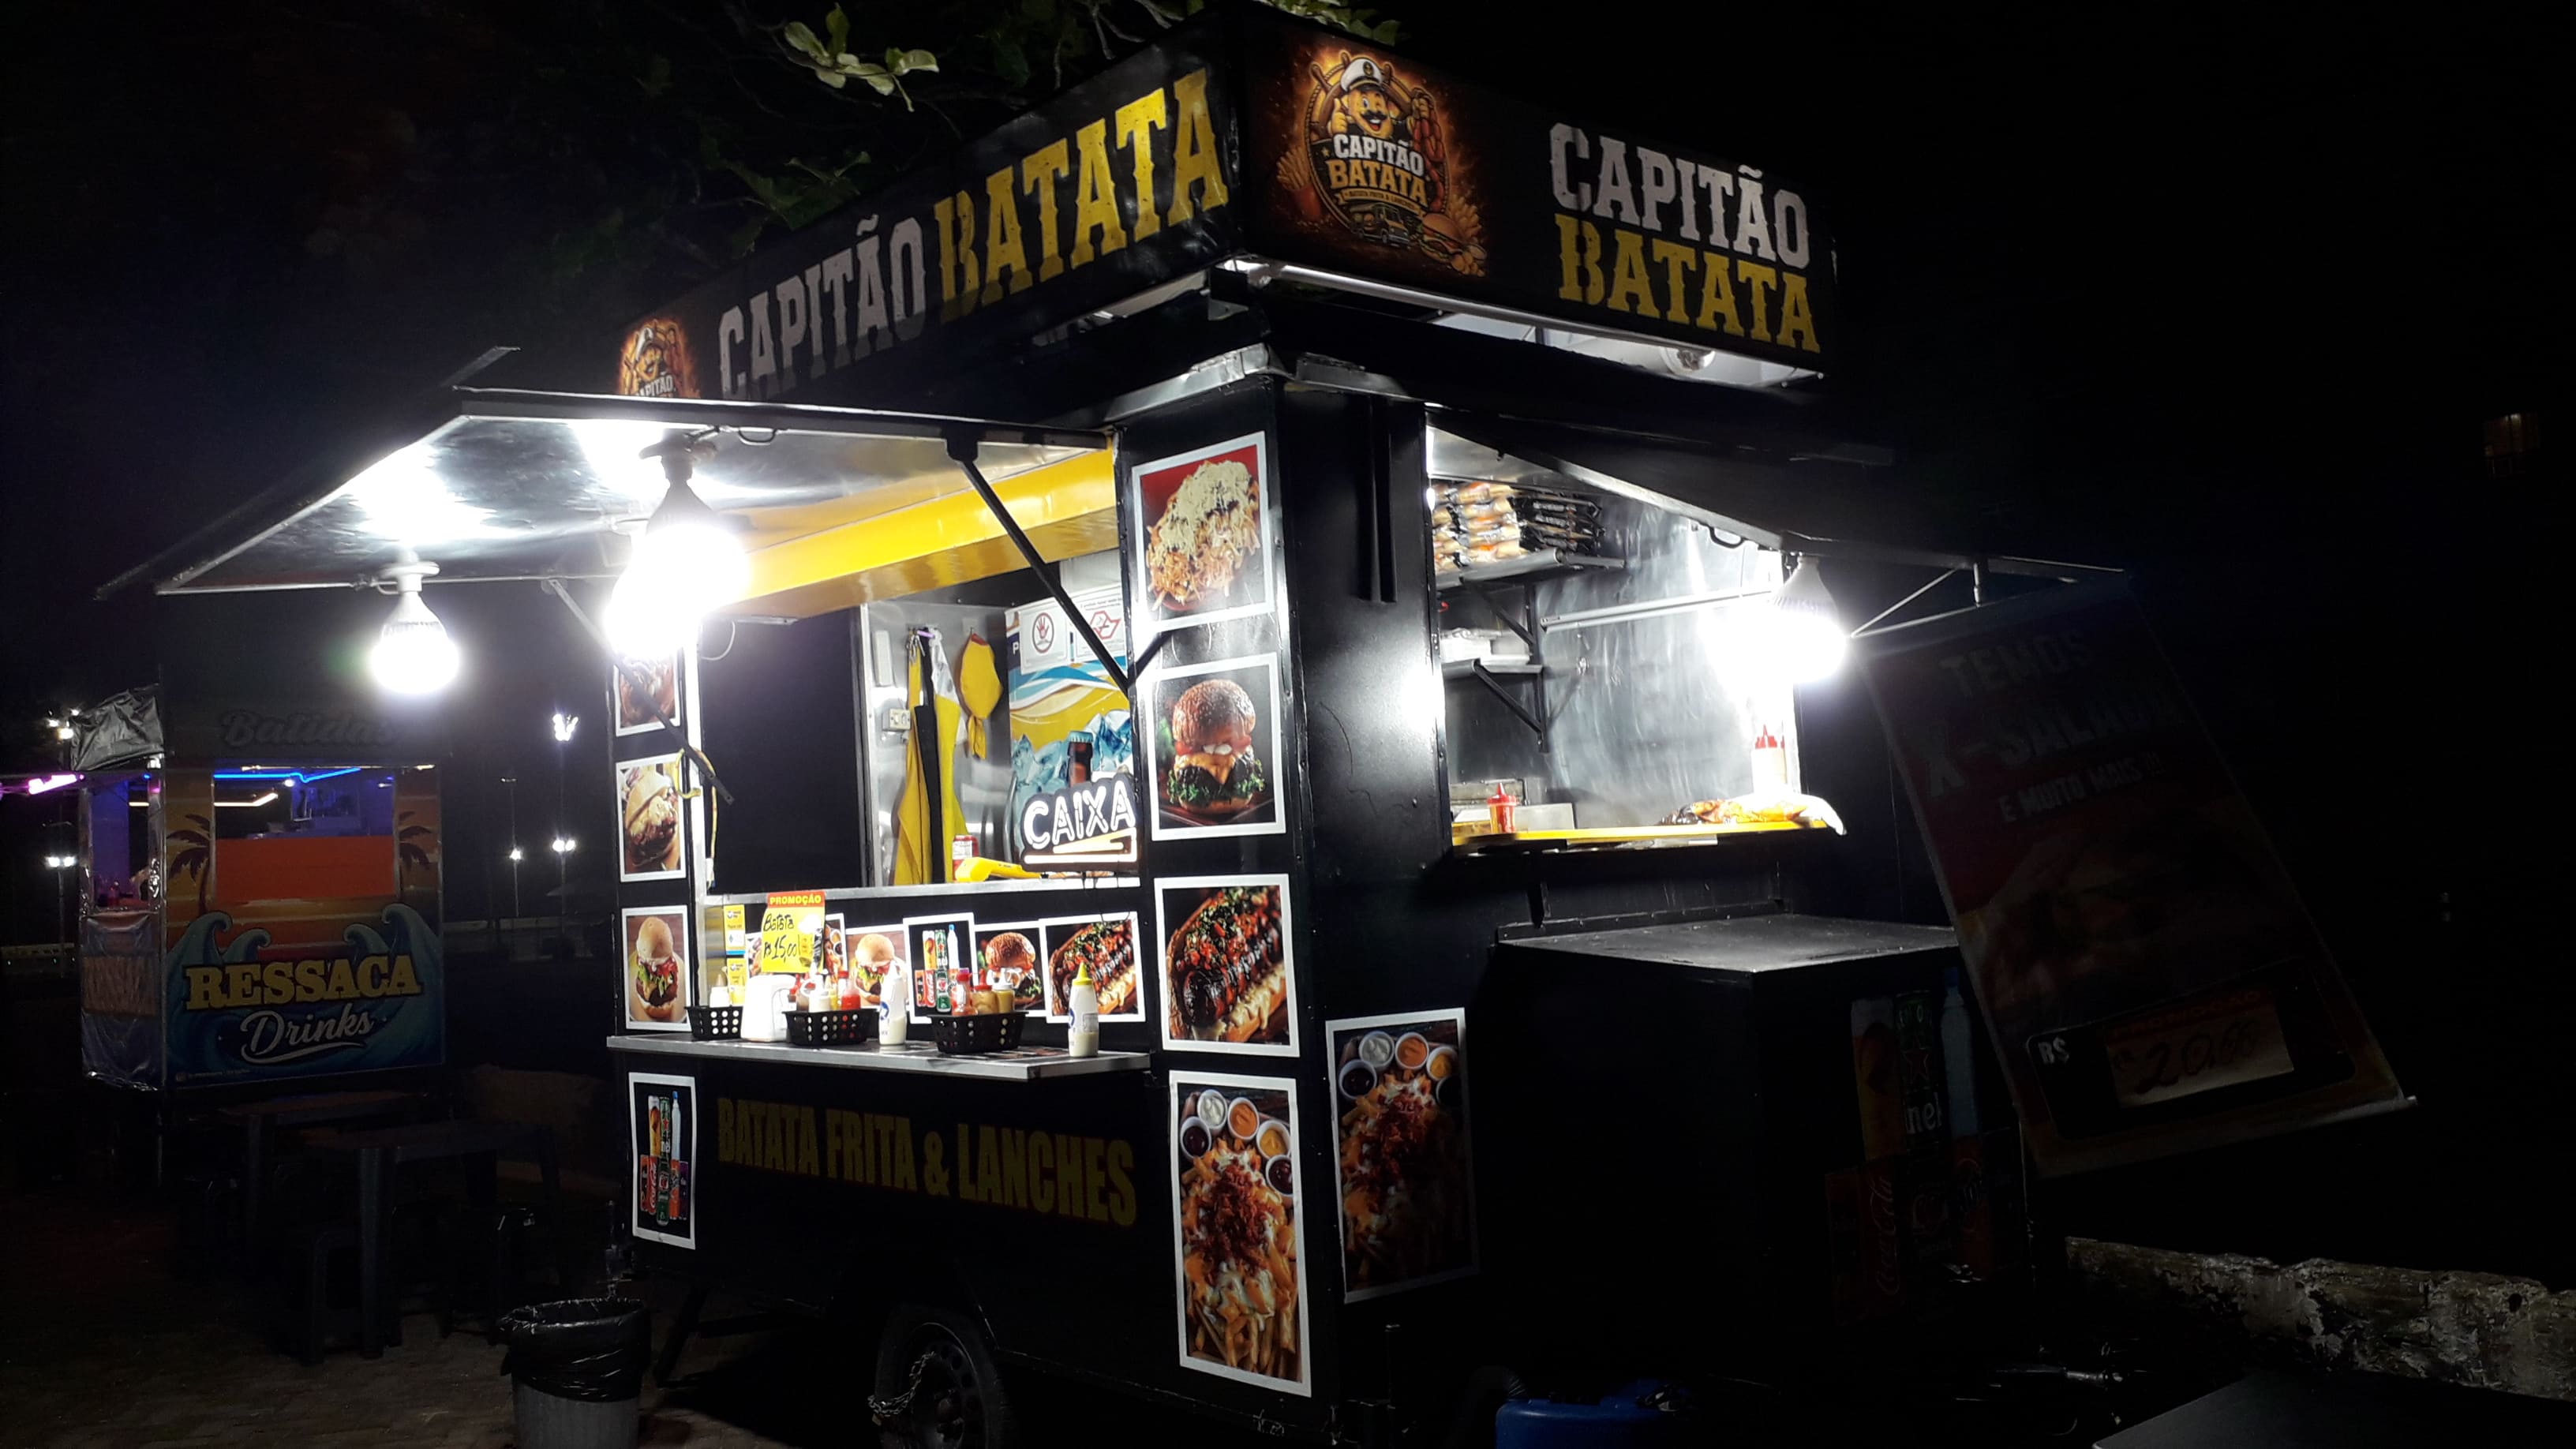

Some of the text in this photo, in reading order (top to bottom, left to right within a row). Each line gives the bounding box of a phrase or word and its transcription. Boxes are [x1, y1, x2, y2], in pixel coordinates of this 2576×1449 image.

[1325, 158, 1428, 208] BATATA
[1333, 133, 1425, 177] CAPITÃO
[1549, 122, 1809, 269] CAPITÃO
[718, 67, 1230, 399] CAPITÃO BATATA
[1554, 213, 1820, 353] BATATA
[1940, 629, 2095, 698] TEMOS
[1024, 780, 1136, 849] CAIXA
[2017, 773, 2087, 817] MUITO
[2087, 755, 2144, 792] MAIS
[769, 893, 822, 905] PROMOÇÃO
[185, 953, 423, 1011] RESSACA
[239, 1002, 374, 1061] Drinks
[717, 1098, 1136, 1228] BATATA FRITA & LANCHES
